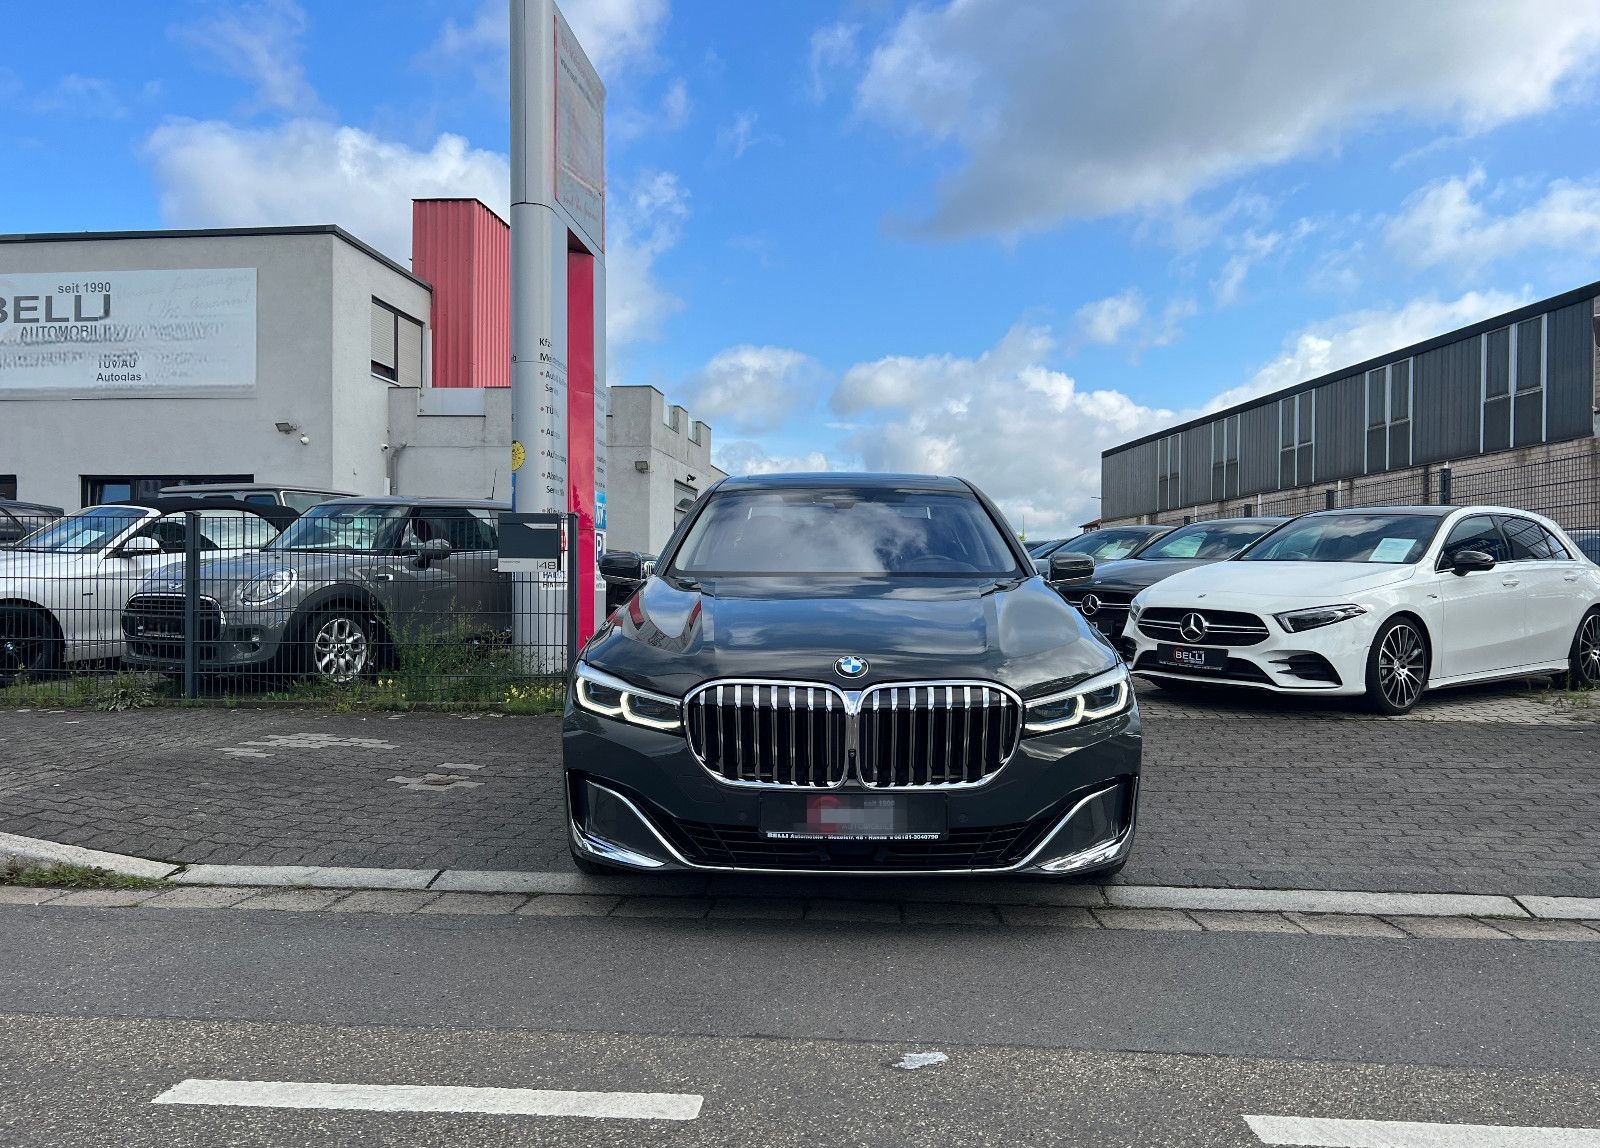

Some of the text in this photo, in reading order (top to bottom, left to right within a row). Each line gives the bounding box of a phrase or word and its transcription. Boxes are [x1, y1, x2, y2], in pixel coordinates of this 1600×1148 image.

[57, 281, 111, 294] seit 1990
[1175, 650, 1204, 662] BELLI
